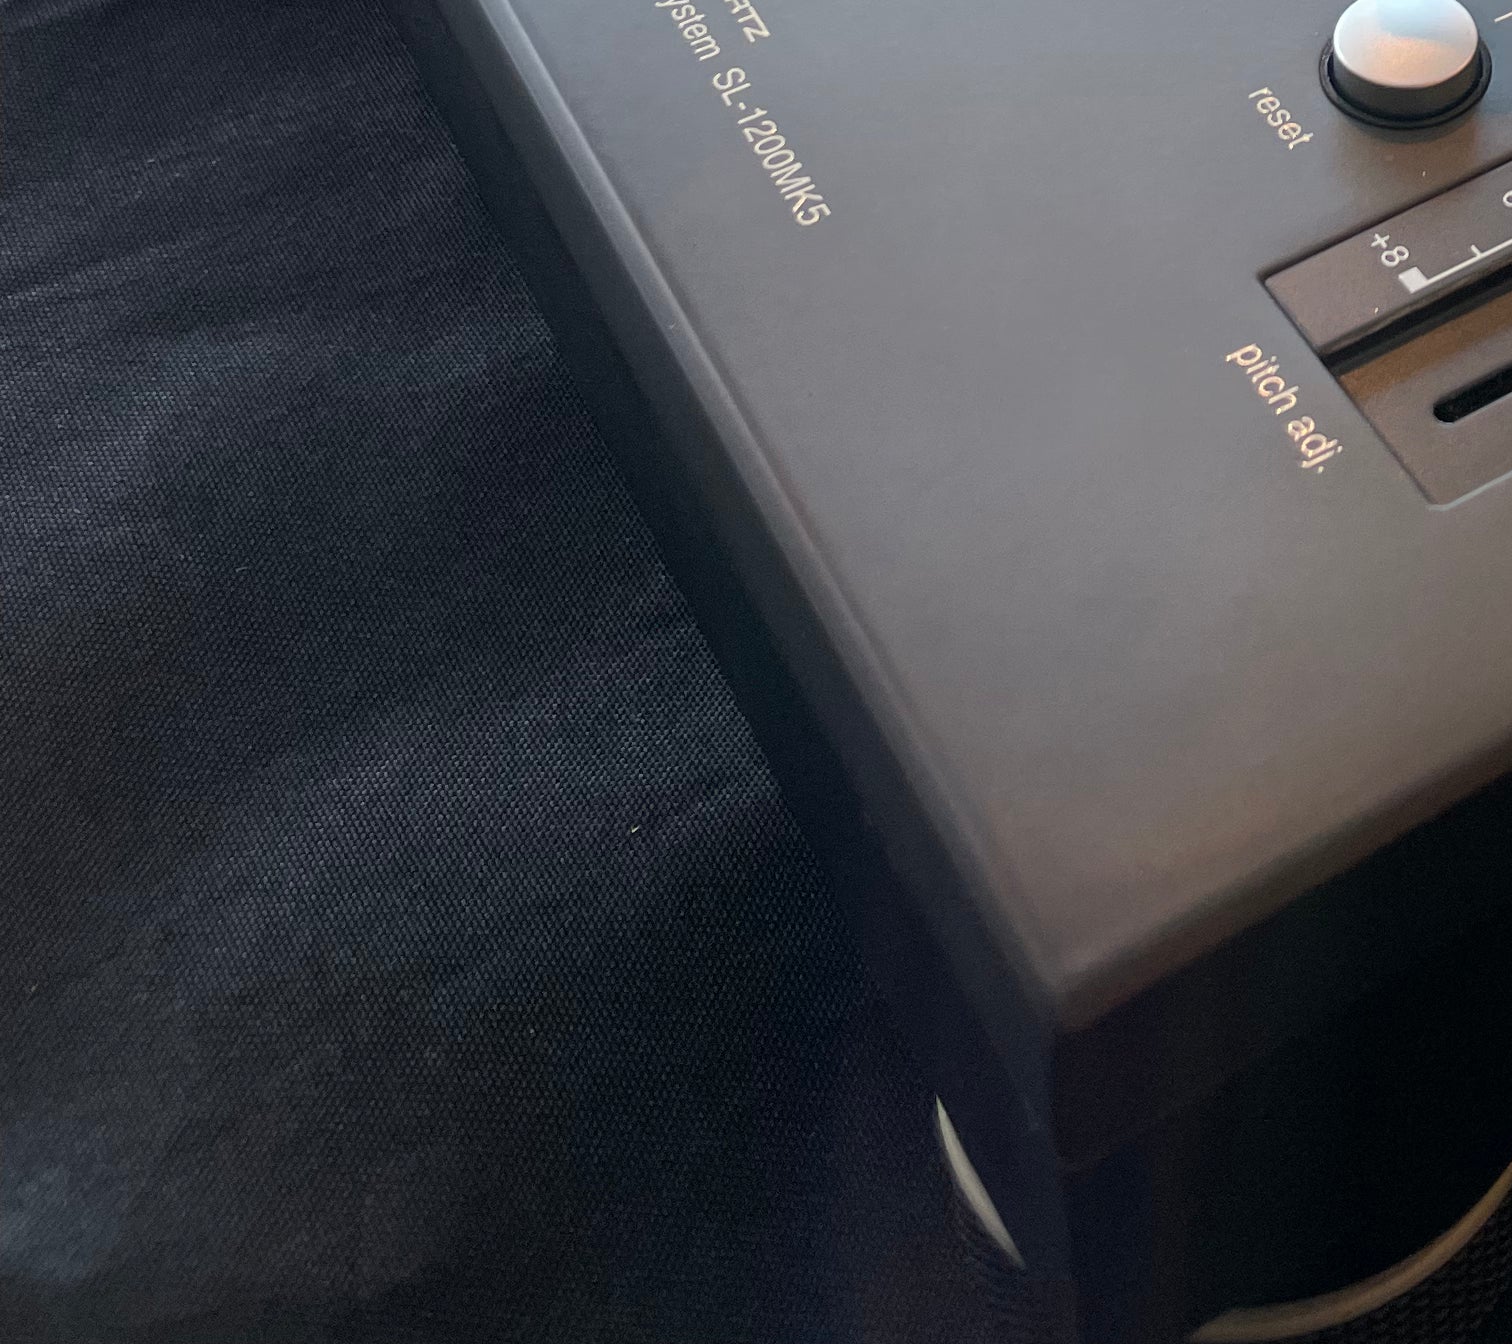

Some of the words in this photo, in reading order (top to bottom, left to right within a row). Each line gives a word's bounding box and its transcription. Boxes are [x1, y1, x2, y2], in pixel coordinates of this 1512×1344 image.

[712, 66, 832, 227] SL-1200MK5
[1248, 86, 1314, 151] reset
[1370, 232, 1410, 268] +8
[1225, 342, 1300, 415] pitch
[1287, 415, 1343, 474] adj.
